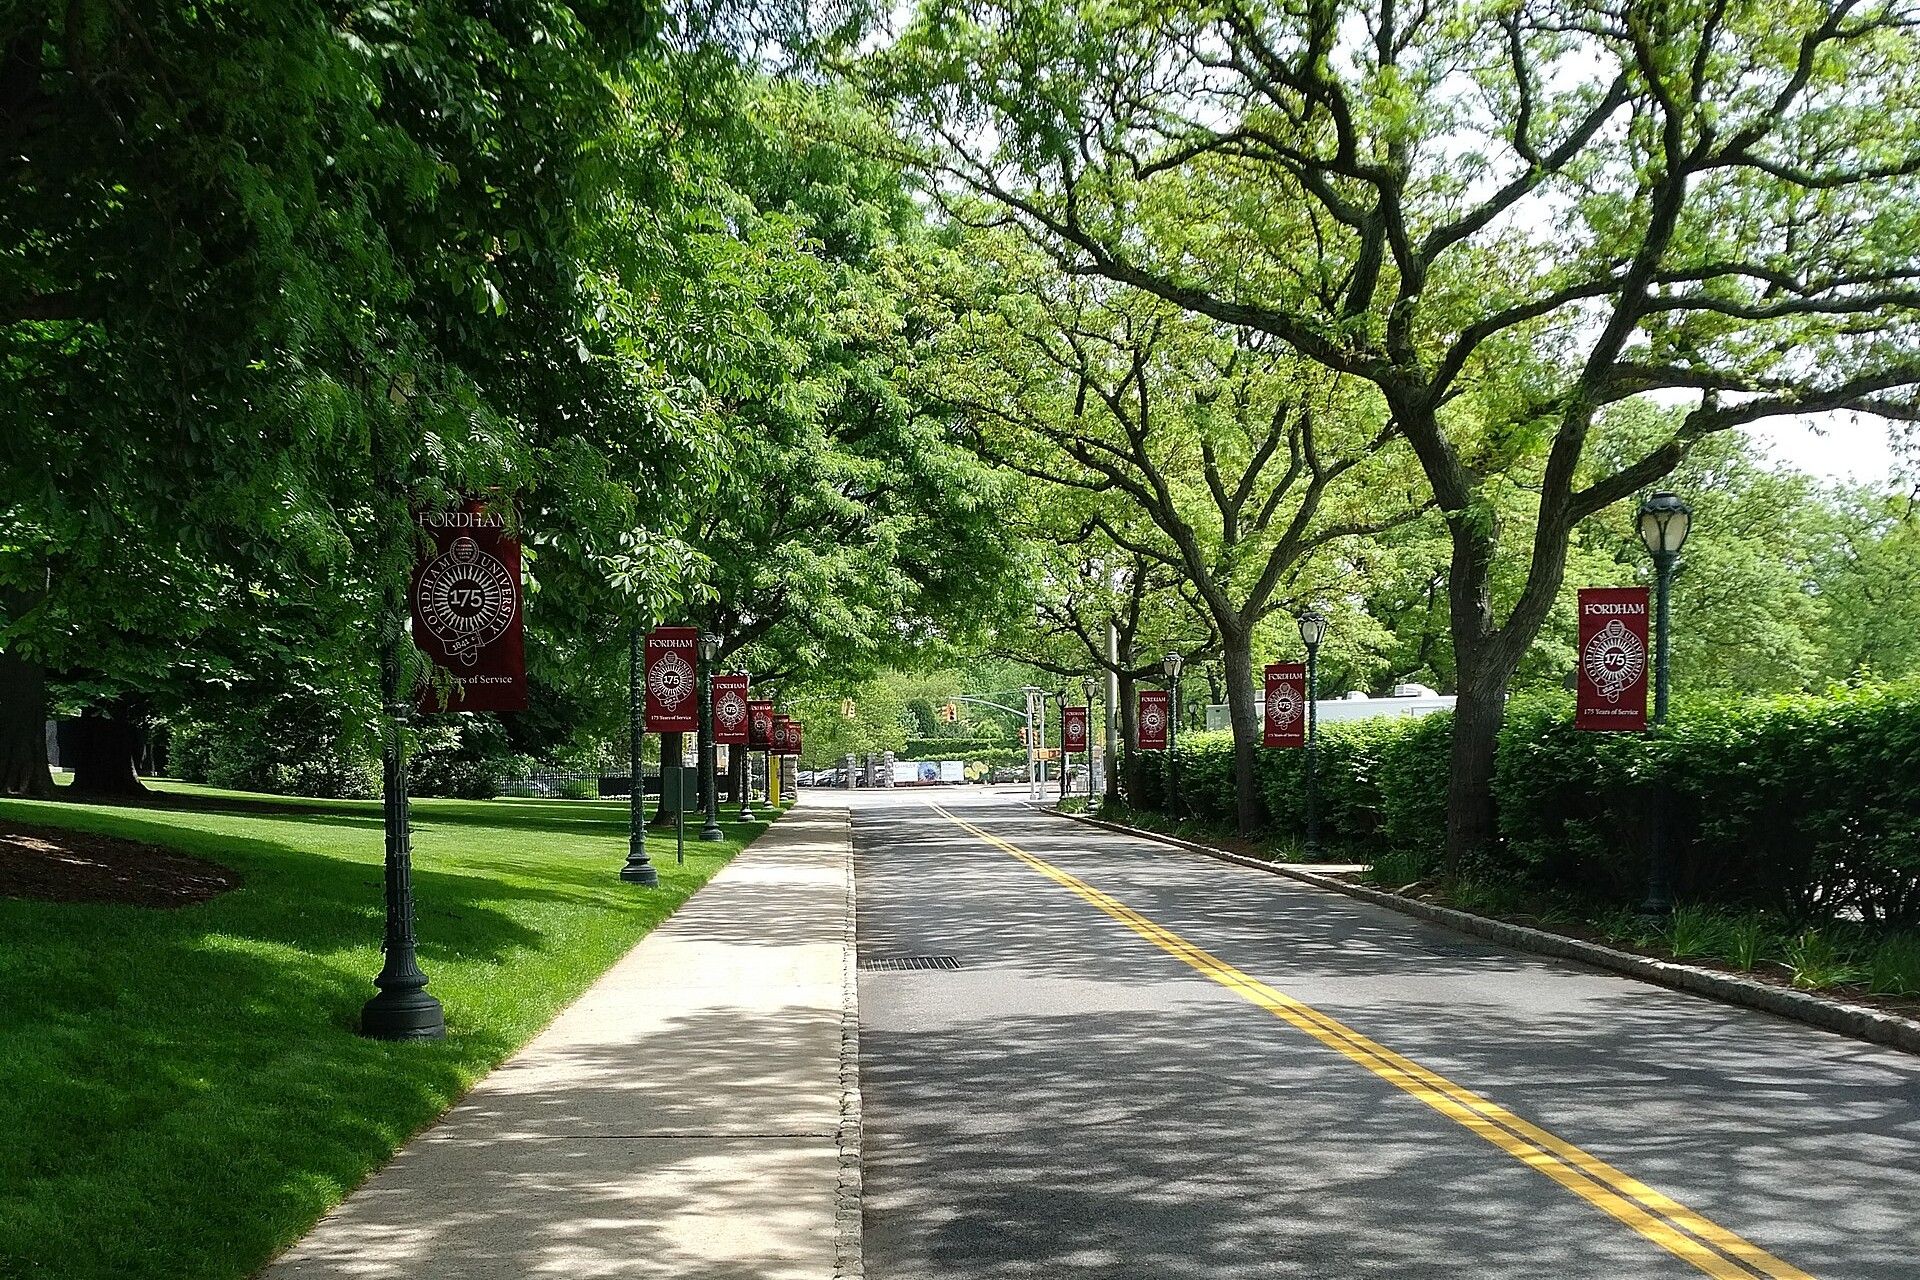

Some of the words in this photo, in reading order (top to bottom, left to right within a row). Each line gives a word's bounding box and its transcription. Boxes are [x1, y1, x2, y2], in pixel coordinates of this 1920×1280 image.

[421, 557, 451, 634] FORDHAM
[481, 556, 513, 635] UNIVERSITY
[450, 589, 483, 608] 175
[1585, 603, 1645, 615] FORDHAM
[649, 639, 693, 648] FORDHAM
[1605, 653, 1626, 666] 175
[469, 675, 479, 684] of
[480, 675, 513, 684] Service
[663, 675, 680, 685] 175
[1278, 701, 1291, 709] 175
